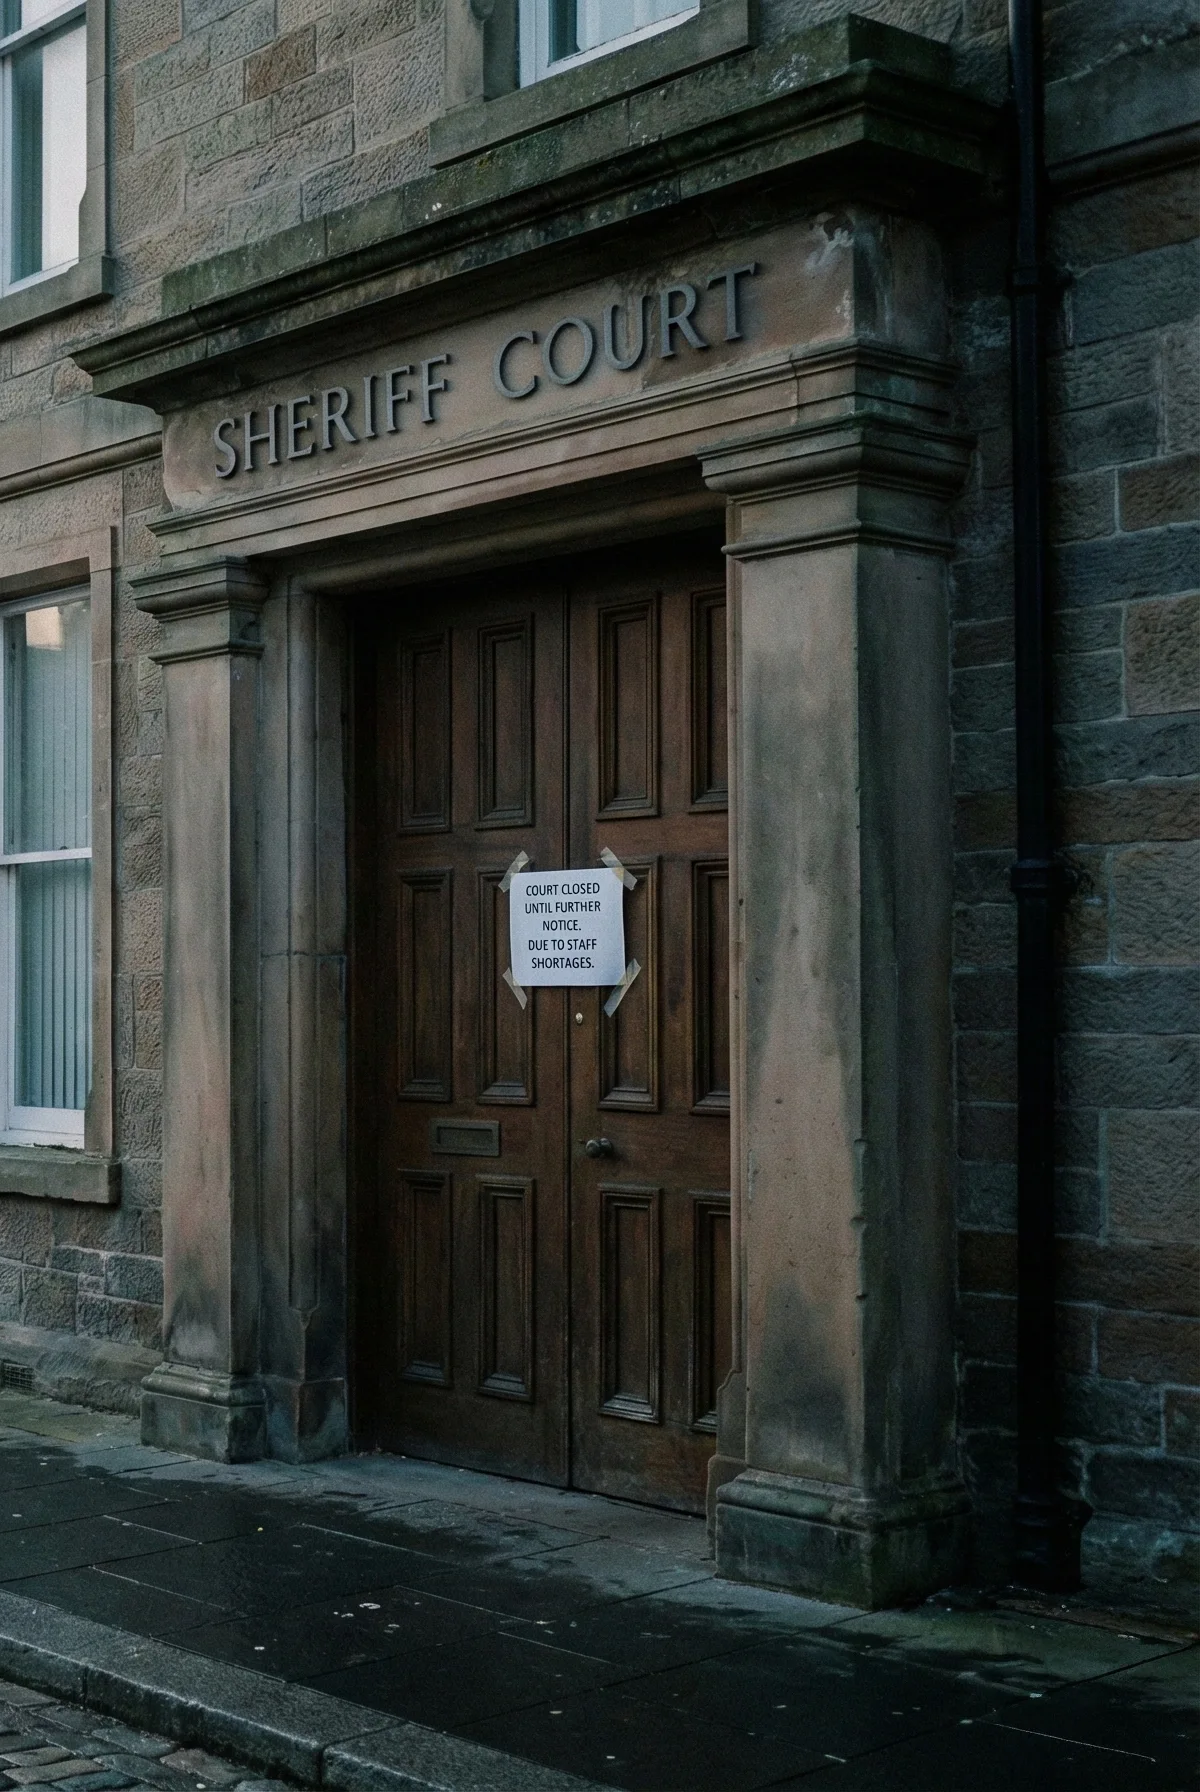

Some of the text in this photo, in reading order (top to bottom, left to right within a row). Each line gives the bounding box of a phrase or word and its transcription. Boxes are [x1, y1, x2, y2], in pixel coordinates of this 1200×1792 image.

[212, 261, 759, 479] SHERIFF COURT
[526, 882, 600, 896] COURT CLOSED
[525, 901, 601, 914] UNTIL FURTHER
[542, 920, 581, 931] NOTICE.
[528, 938, 597, 950] DUE TO STAFF
[531, 957, 594, 968] SHORTAGES.
